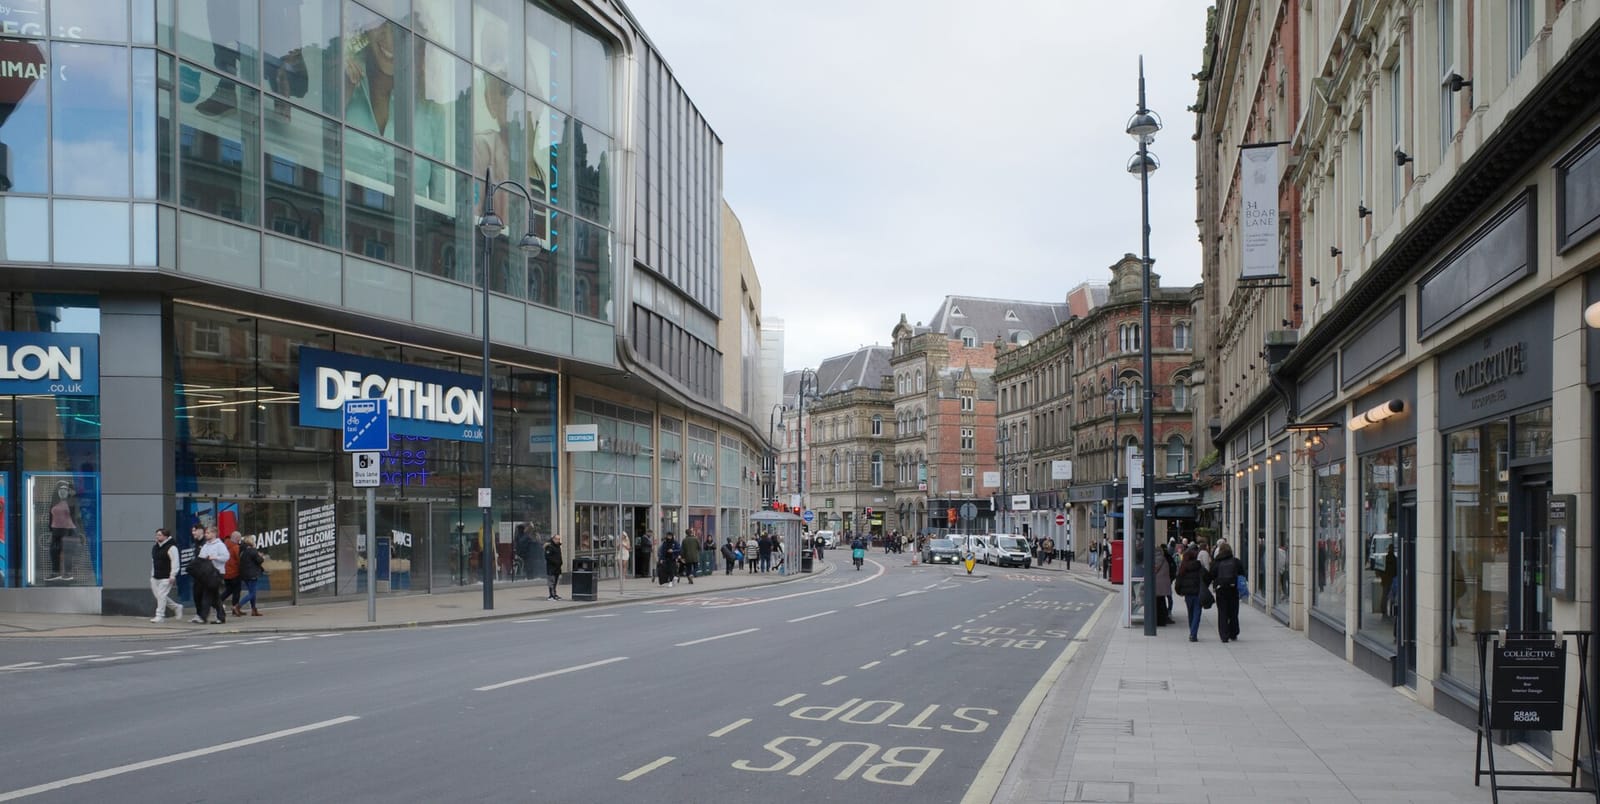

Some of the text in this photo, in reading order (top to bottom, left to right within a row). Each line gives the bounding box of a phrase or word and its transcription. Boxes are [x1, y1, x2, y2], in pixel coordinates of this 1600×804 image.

[1246, 209, 1275, 218] BOAR
[1246, 218, 1273, 227] LANE
[1454, 342, 1525, 394] COLLECTIVE
[47, 383, 82, 393] .co.uk
[316, 366, 483, 426] DECATHLON
[462, 429, 483, 440] .co.uk
[299, 529, 335, 548] WELCOME
[962, 626, 1069, 638] STOP
[952, 636, 1047, 649] BUS
[789, 698, 999, 733] STOP
[731, 736, 944, 786] BUS
